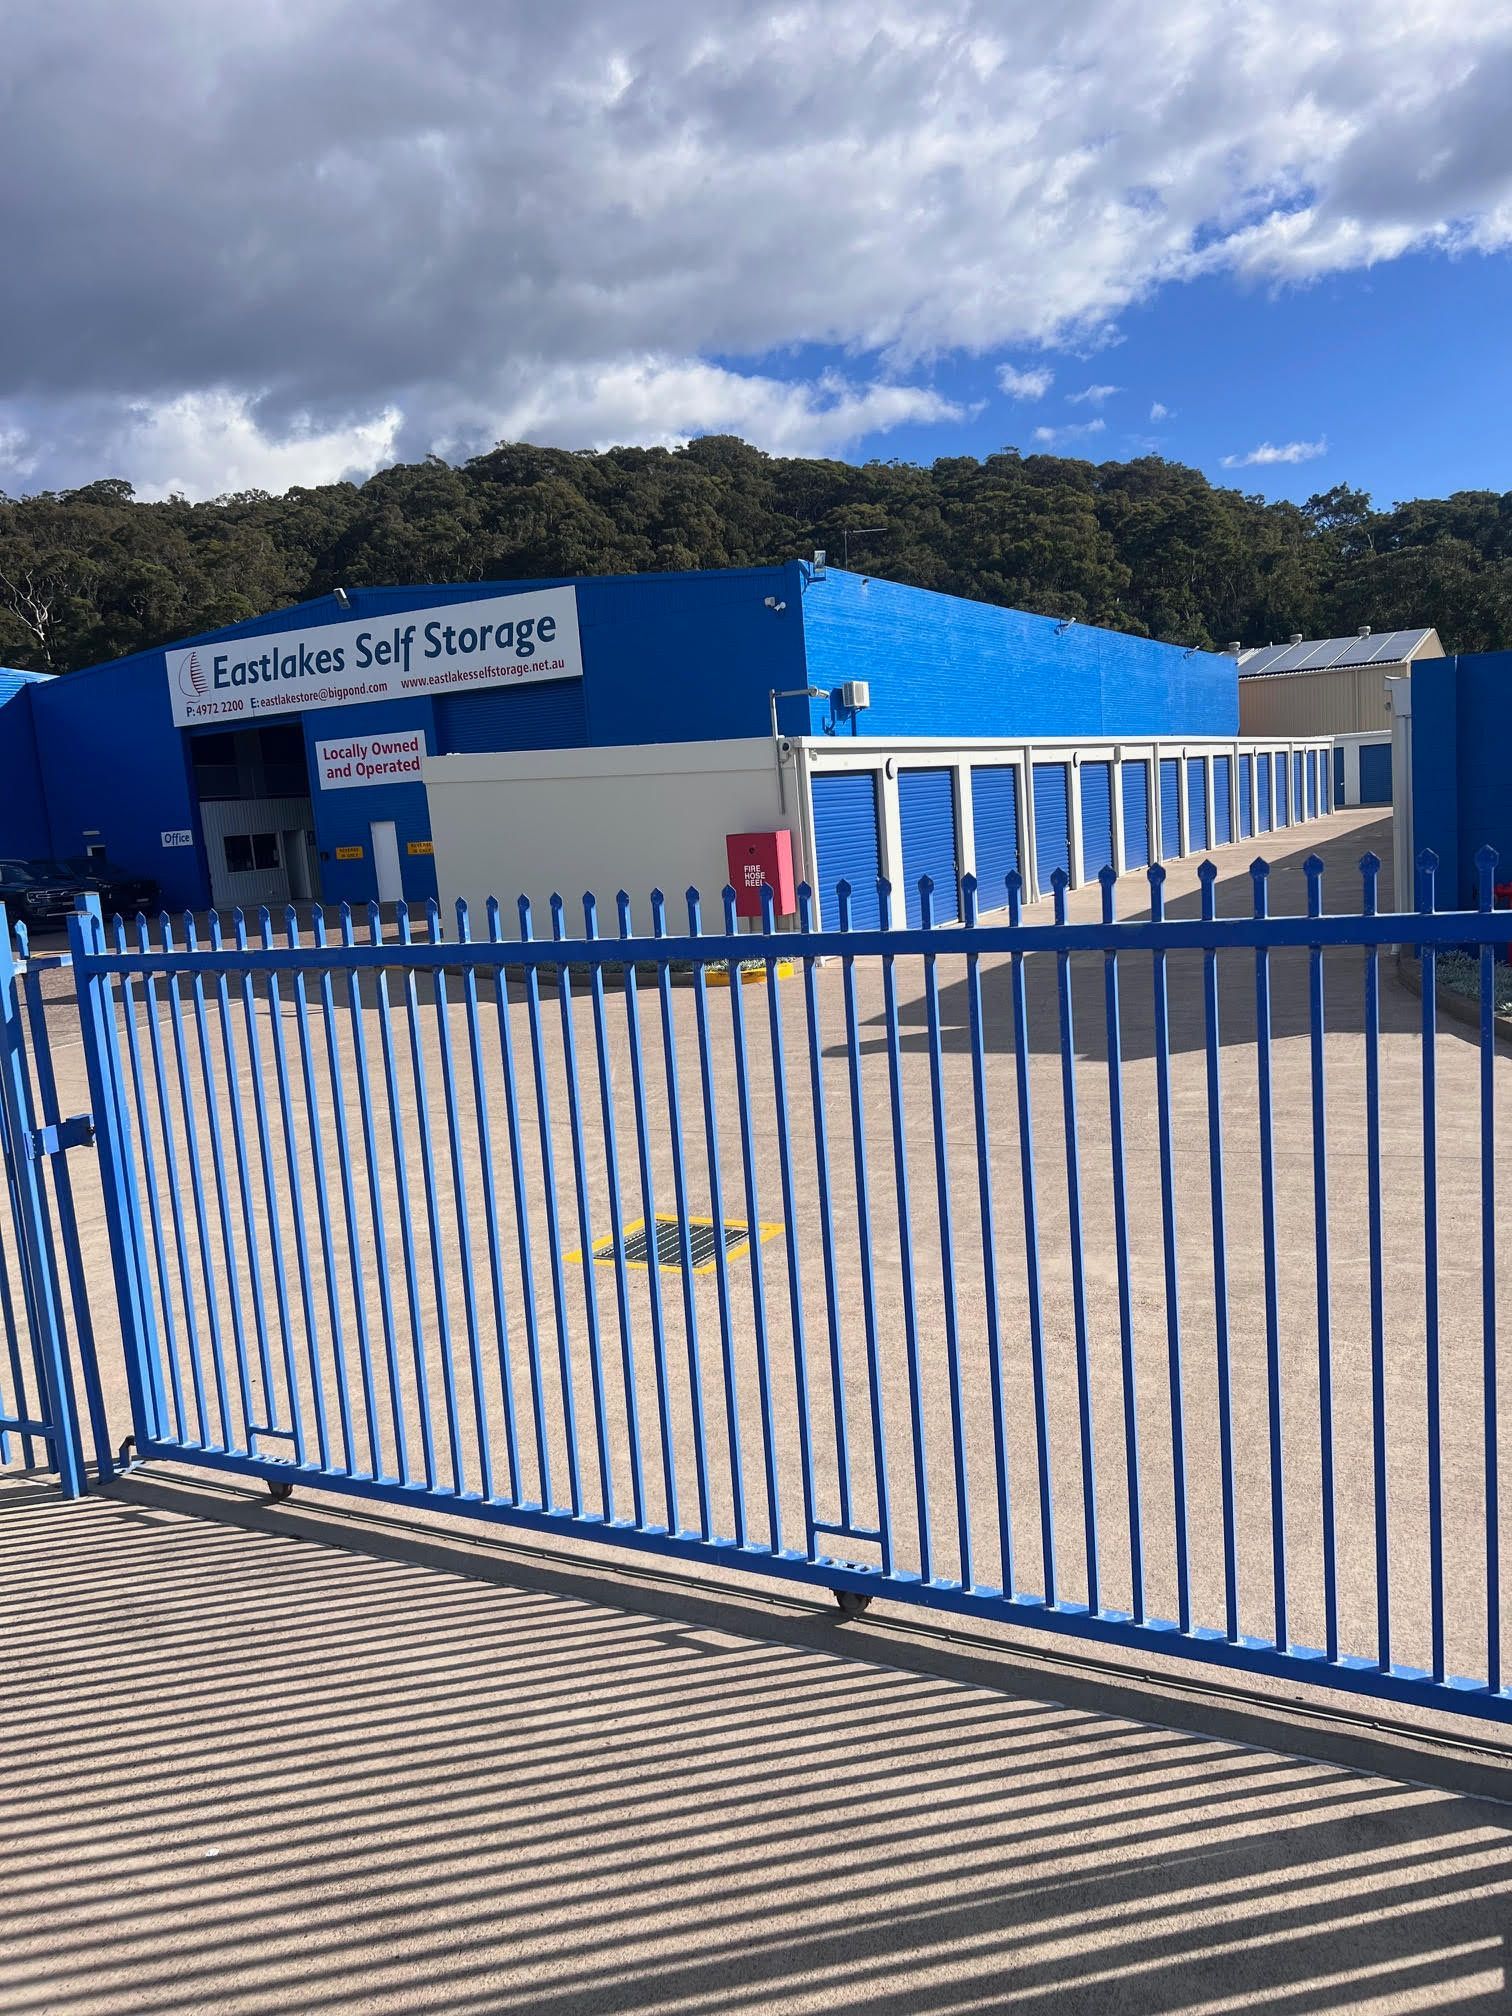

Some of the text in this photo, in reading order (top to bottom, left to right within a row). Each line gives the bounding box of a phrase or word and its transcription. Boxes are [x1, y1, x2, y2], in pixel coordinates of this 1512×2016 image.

[213, 615, 557, 690] Eastlakes Self Storage
[222, 700, 244, 713] 2200
[400, 658, 565, 689] www.eastlakesselfstorage.net.au
[323, 736, 419, 760] Locally Owned
[326, 755, 421, 779] and Operated
[165, 833, 190, 846] Office
[744, 872, 766, 880] HOSE
